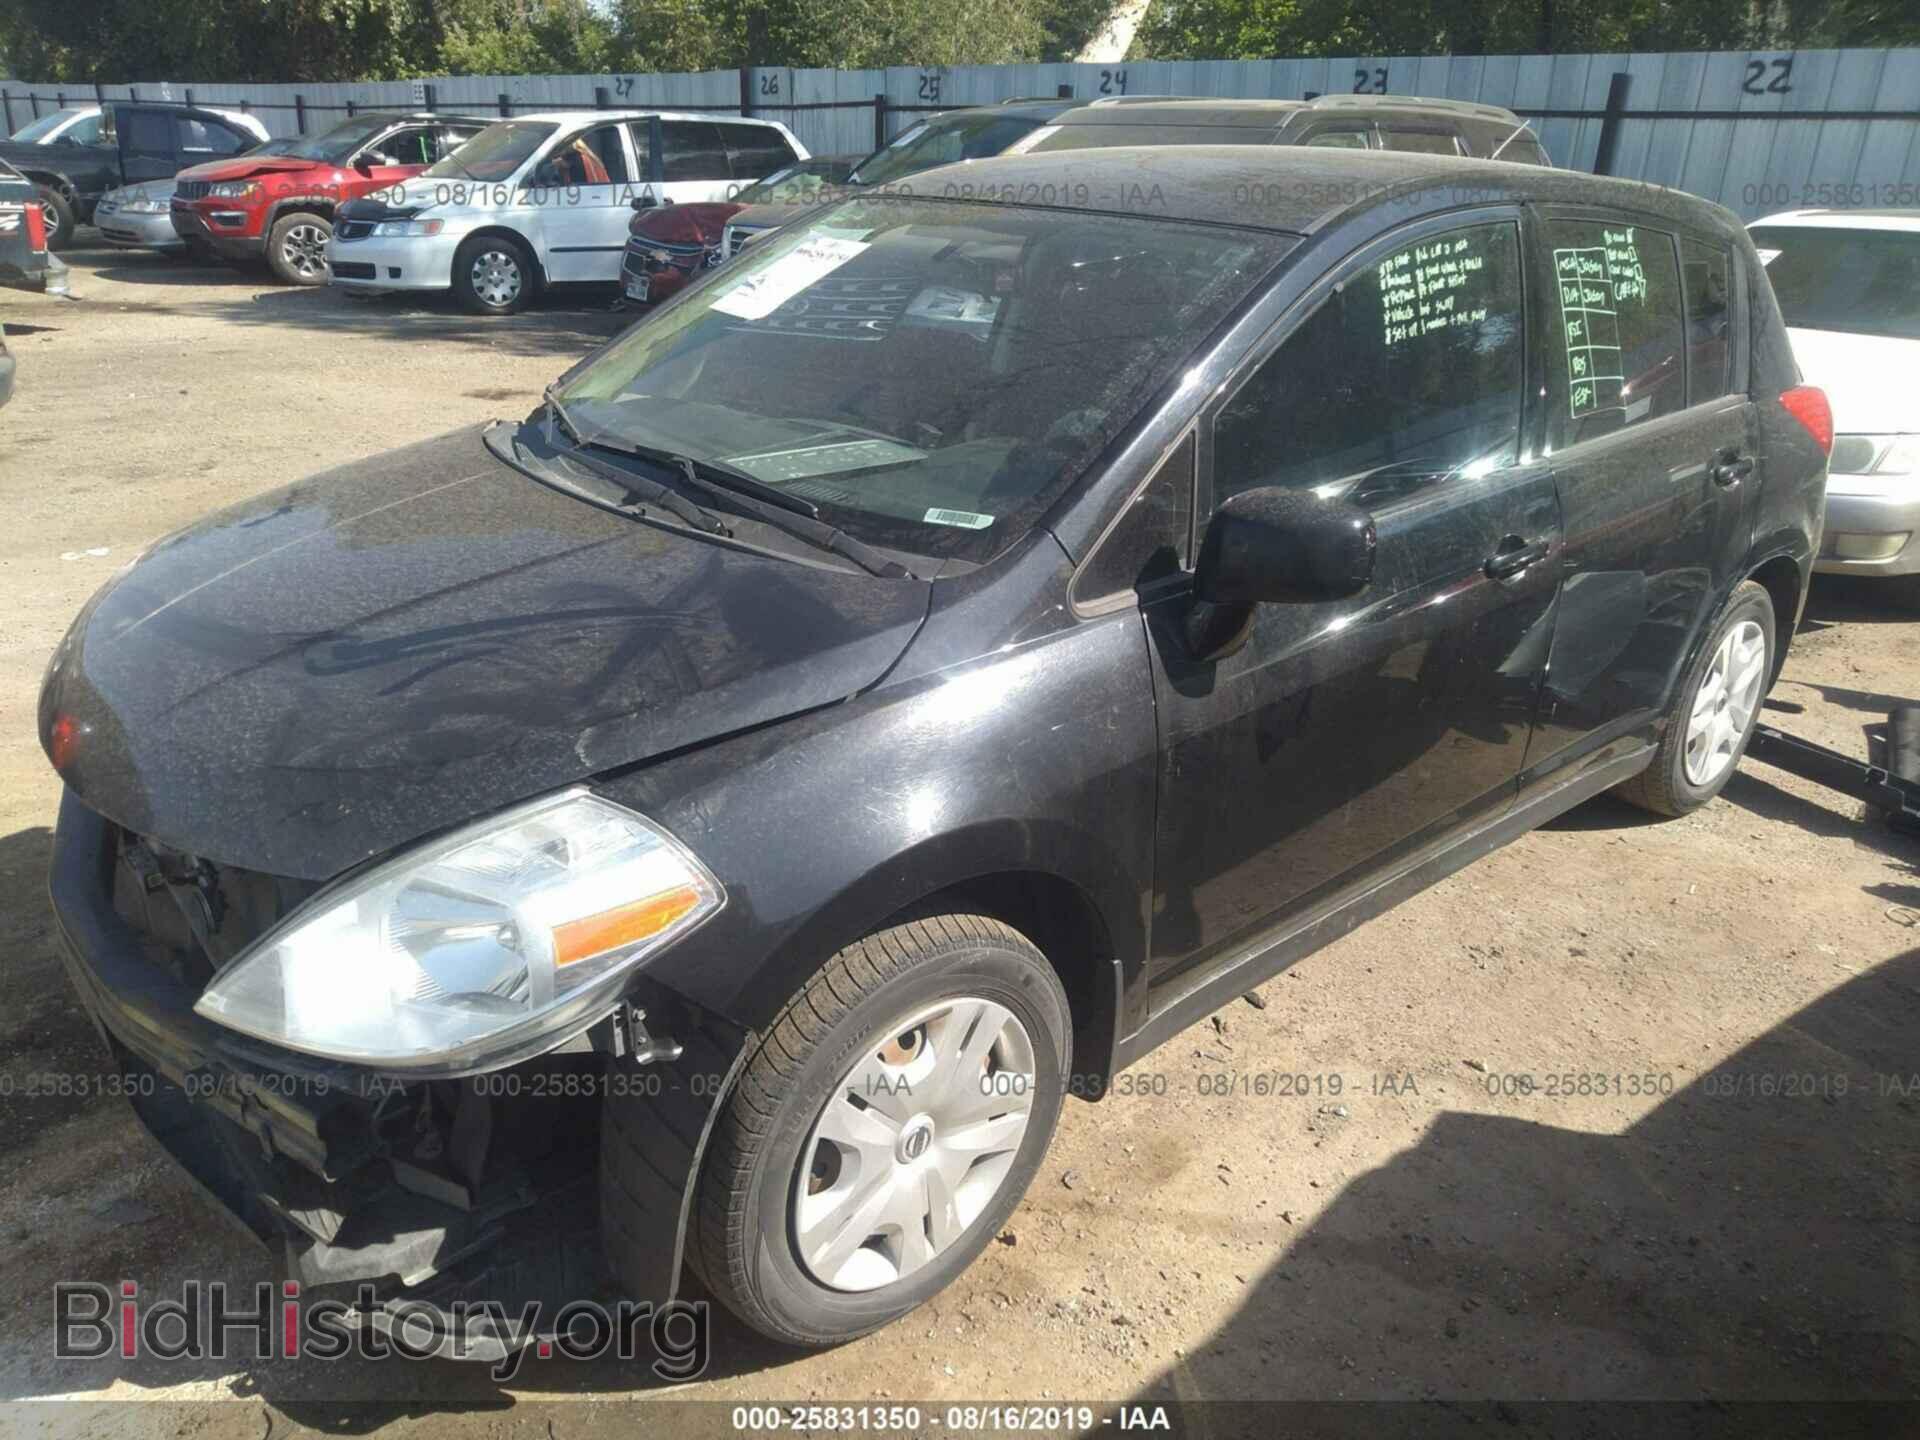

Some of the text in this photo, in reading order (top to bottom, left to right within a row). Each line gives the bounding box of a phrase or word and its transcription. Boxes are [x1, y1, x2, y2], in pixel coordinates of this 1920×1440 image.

[615, 77, 634, 99] 27
[760, 75, 779, 95] 26
[918, 75, 941, 100] 25
[1099, 70, 1128, 96] 24
[1353, 67, 1388, 94] 23
[1742, 59, 1793, 95] 22
